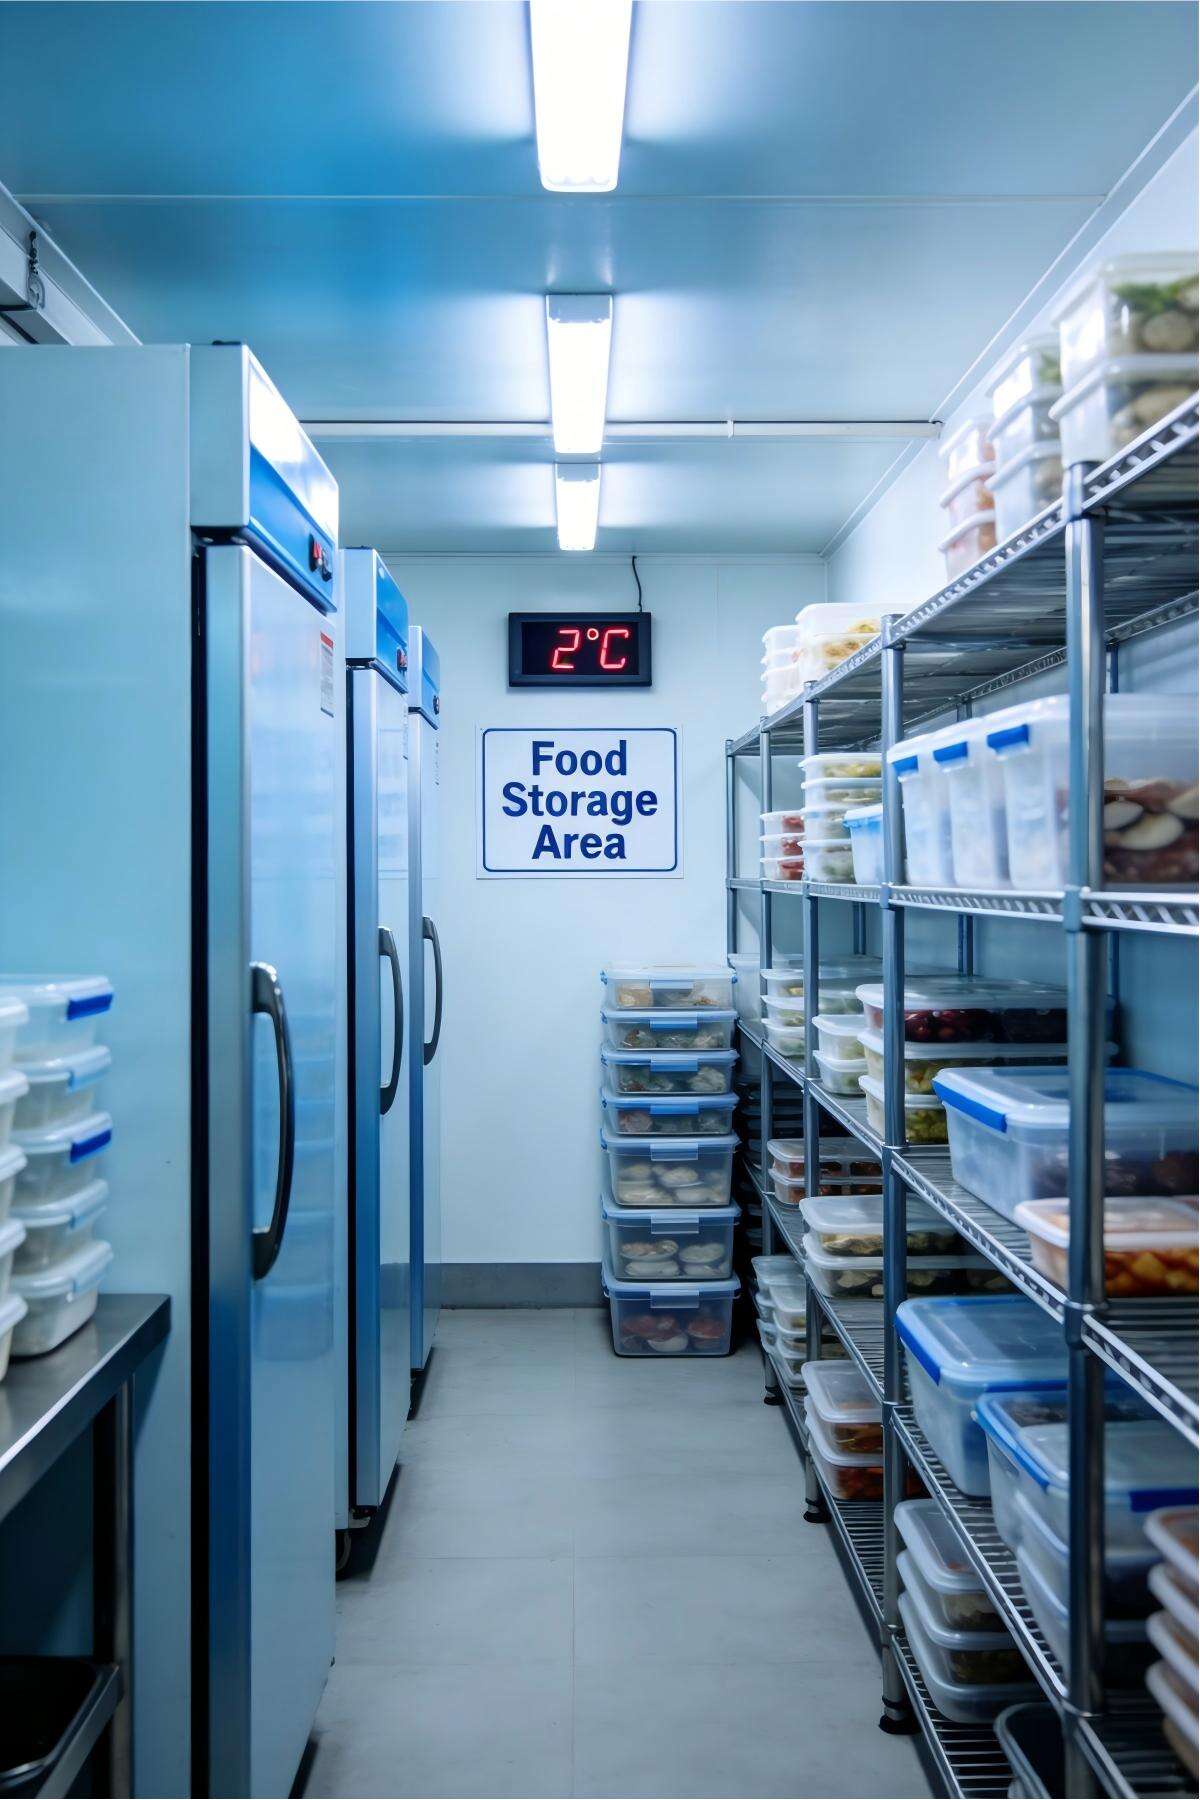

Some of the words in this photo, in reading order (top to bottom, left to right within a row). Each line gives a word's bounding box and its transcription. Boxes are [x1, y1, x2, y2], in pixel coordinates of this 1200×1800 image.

[551, 627, 630, 669] 2°C
[531, 739, 627, 776] Food
[501, 781, 658, 826] Storage
[531, 824, 628, 860] Area
